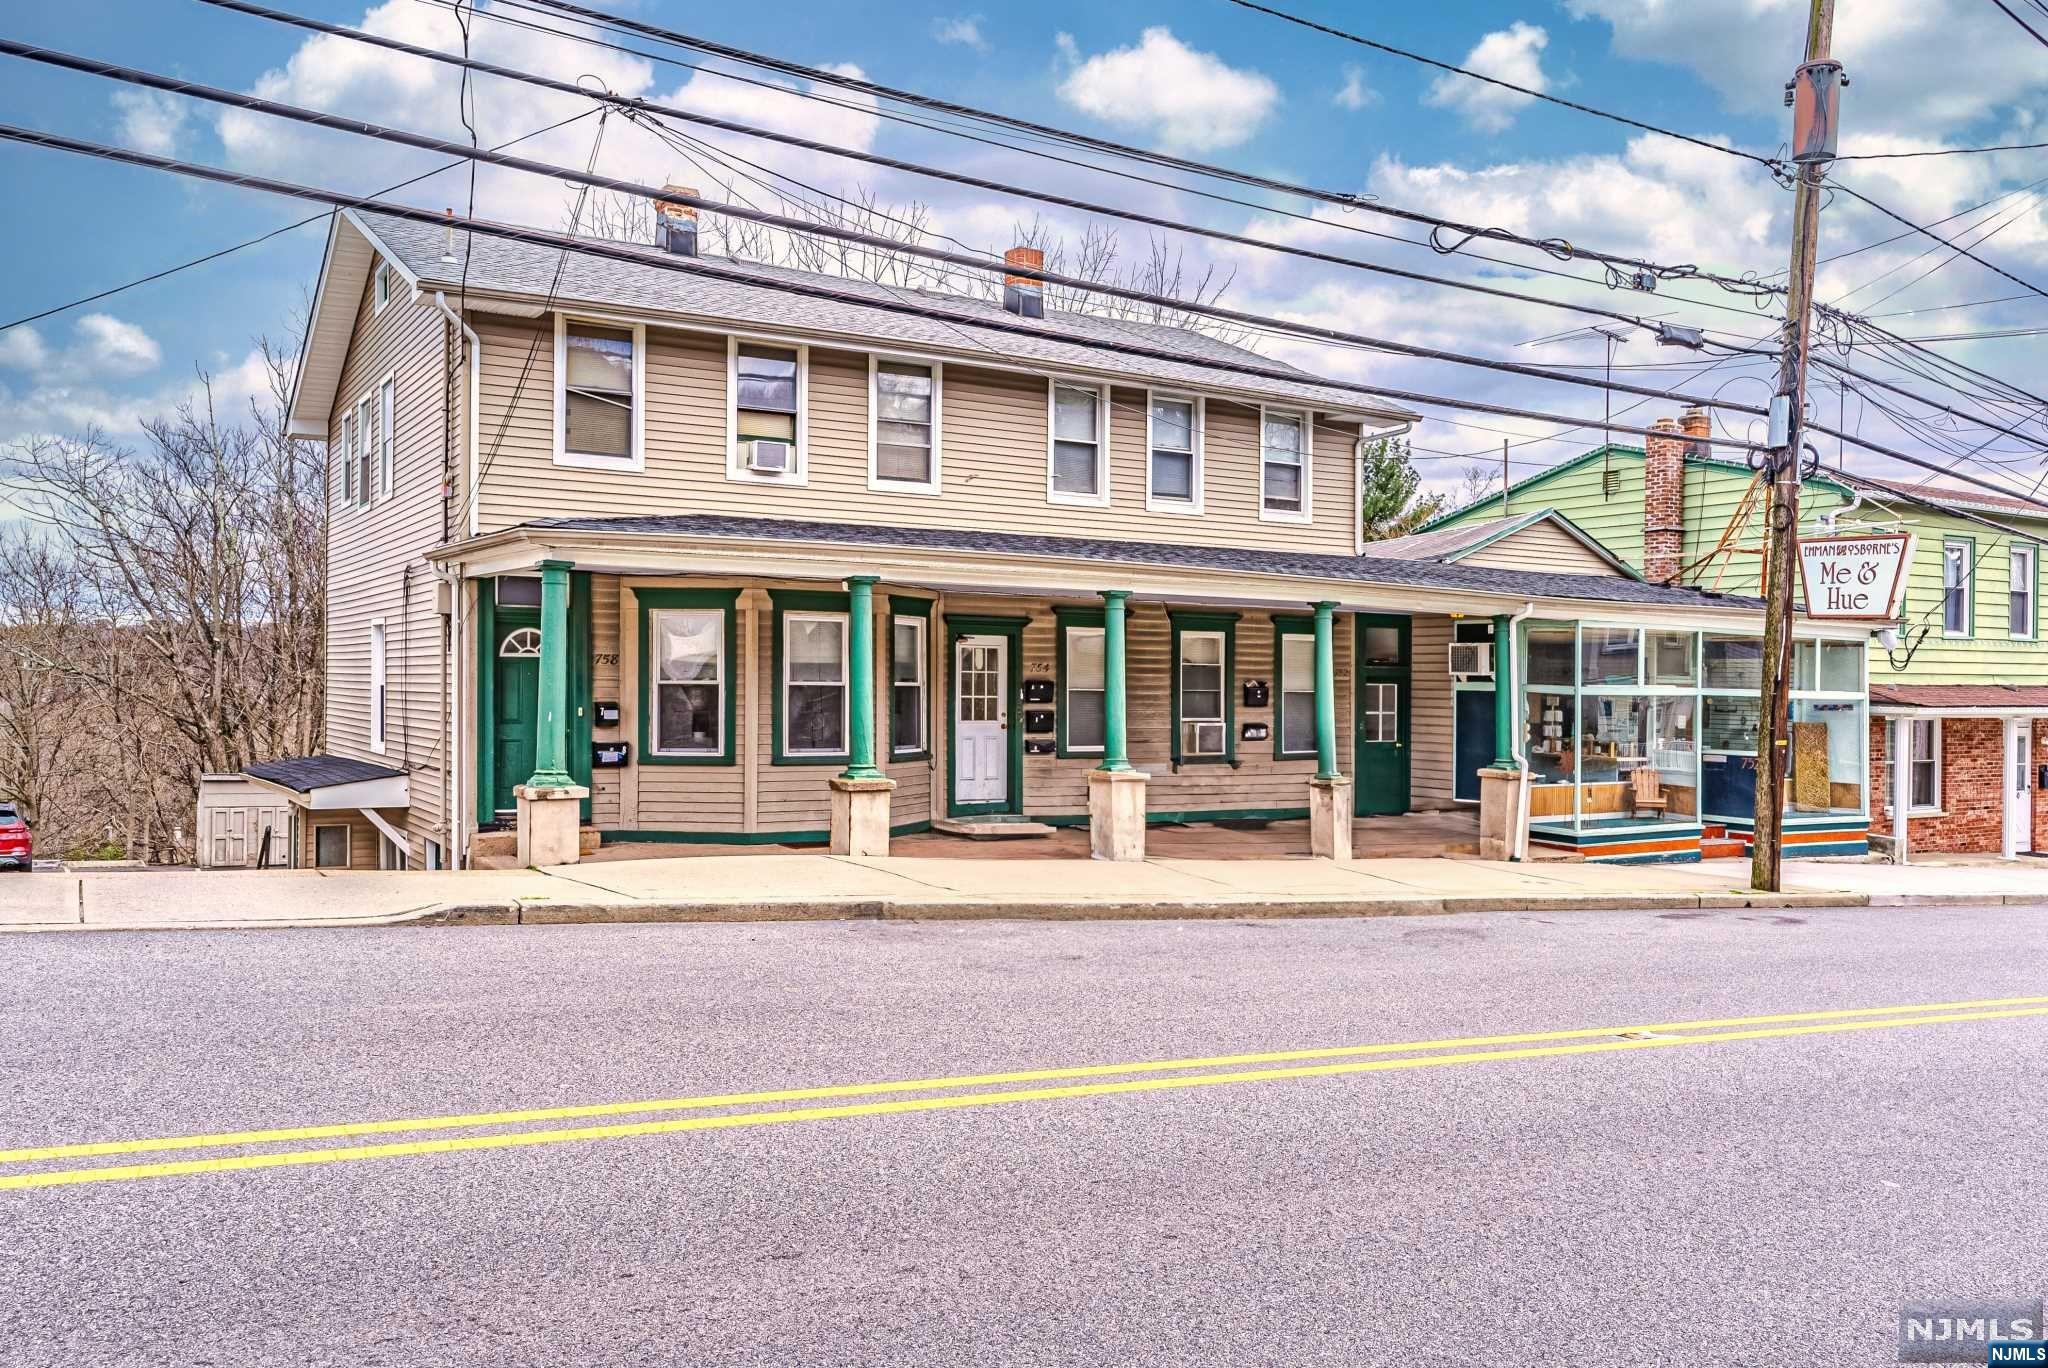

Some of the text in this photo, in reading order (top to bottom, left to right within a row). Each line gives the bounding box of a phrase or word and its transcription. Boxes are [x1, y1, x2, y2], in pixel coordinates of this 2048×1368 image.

[1820, 562, 1880, 585] Me &
[1827, 587, 1869, 610] Hue
[595, 653, 619, 665] 758
[1030, 663, 1050, 673] 754
